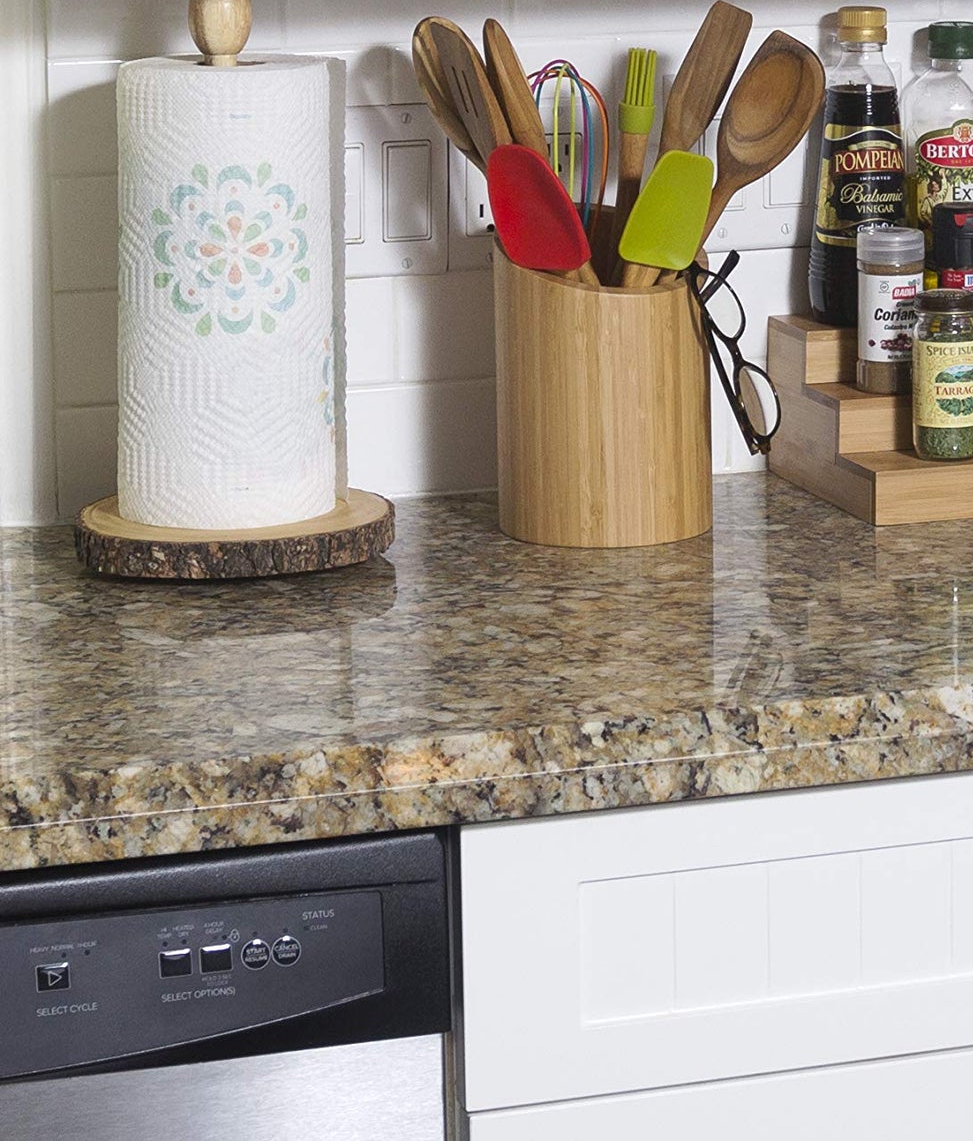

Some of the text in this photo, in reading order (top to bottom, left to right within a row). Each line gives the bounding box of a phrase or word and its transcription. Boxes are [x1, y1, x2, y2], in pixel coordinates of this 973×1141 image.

[835, 150, 904, 172] POMPEIAN
[840, 182, 903, 204] Balsamic
[856, 204, 894, 214] VINEGAR
[894, 288, 915, 297] BADIA
[926, 345, 955, 356] SPICE
[302, 909, 335, 921] STATUS
[274, 943, 298, 952] CANCEL
[161, 986, 236, 1003] SELECT OPTION(S)
[36, 1002, 98, 1017] SELECT CYCLE
